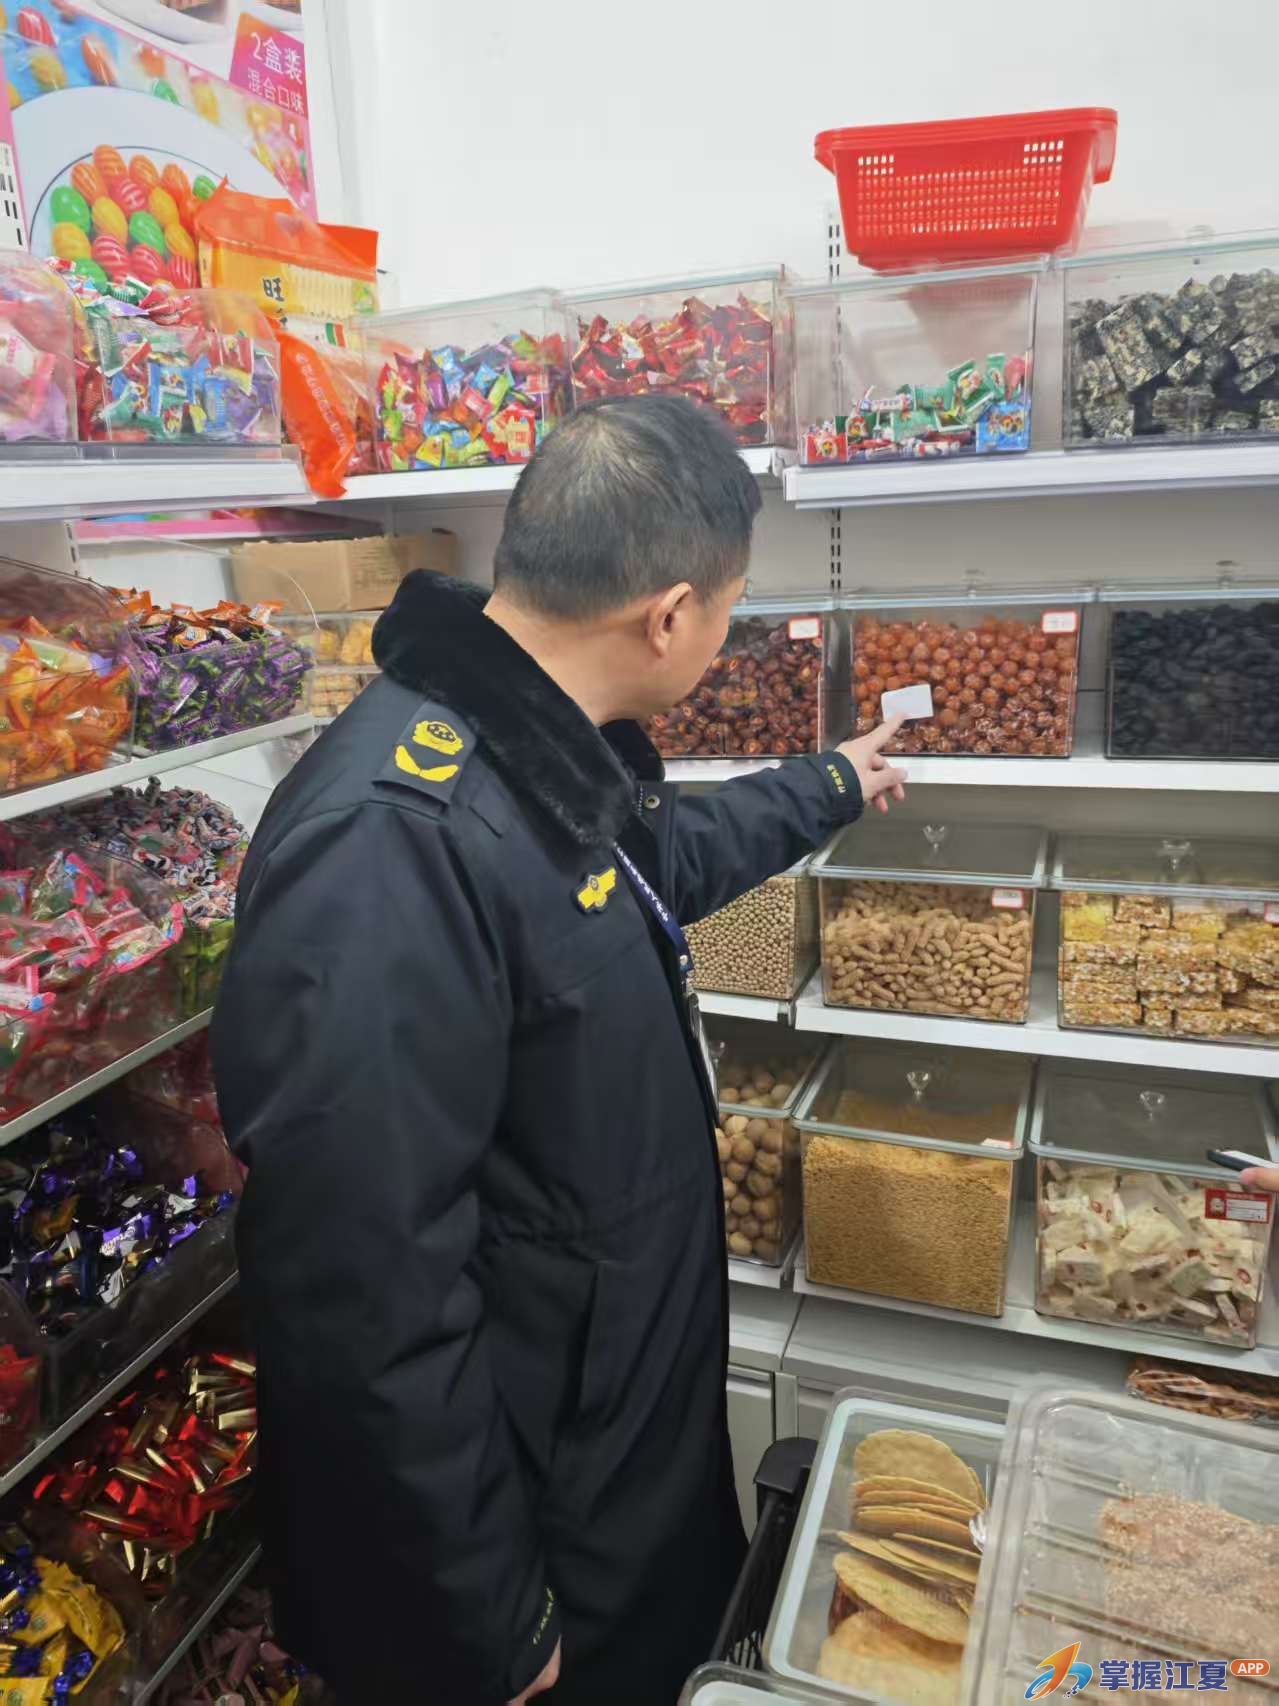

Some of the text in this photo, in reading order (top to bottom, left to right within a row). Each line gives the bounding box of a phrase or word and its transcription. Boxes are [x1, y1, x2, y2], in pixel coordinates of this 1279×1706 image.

[250, 32, 303, 85] 2盒装
[247, 67, 305, 115] 混合口味
